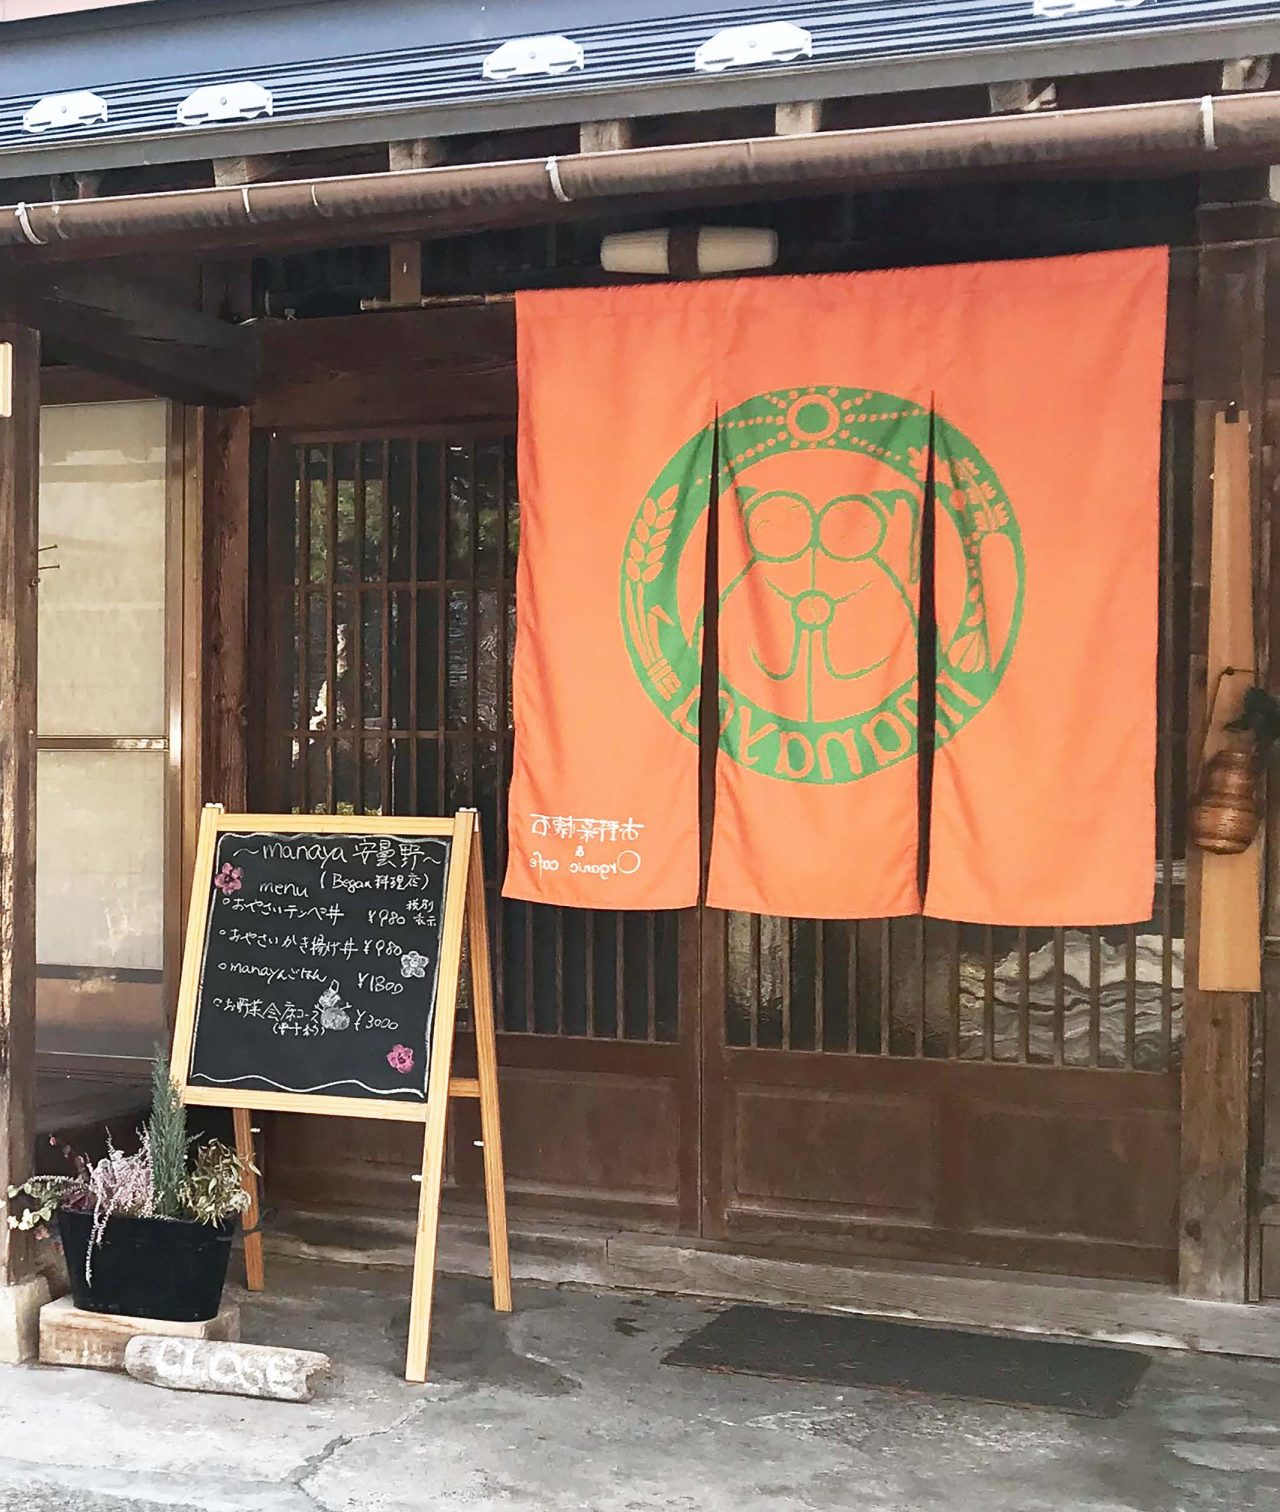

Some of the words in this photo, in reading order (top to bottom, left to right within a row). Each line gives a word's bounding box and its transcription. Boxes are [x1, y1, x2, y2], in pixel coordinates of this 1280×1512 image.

[259, 881, 310, 898] menu
[367, 909, 406, 928] ¥980
[362, 939, 404, 957] ¥980
[357, 972, 404, 995] ¥1800
[353, 1008, 400, 1032] ¥3000
